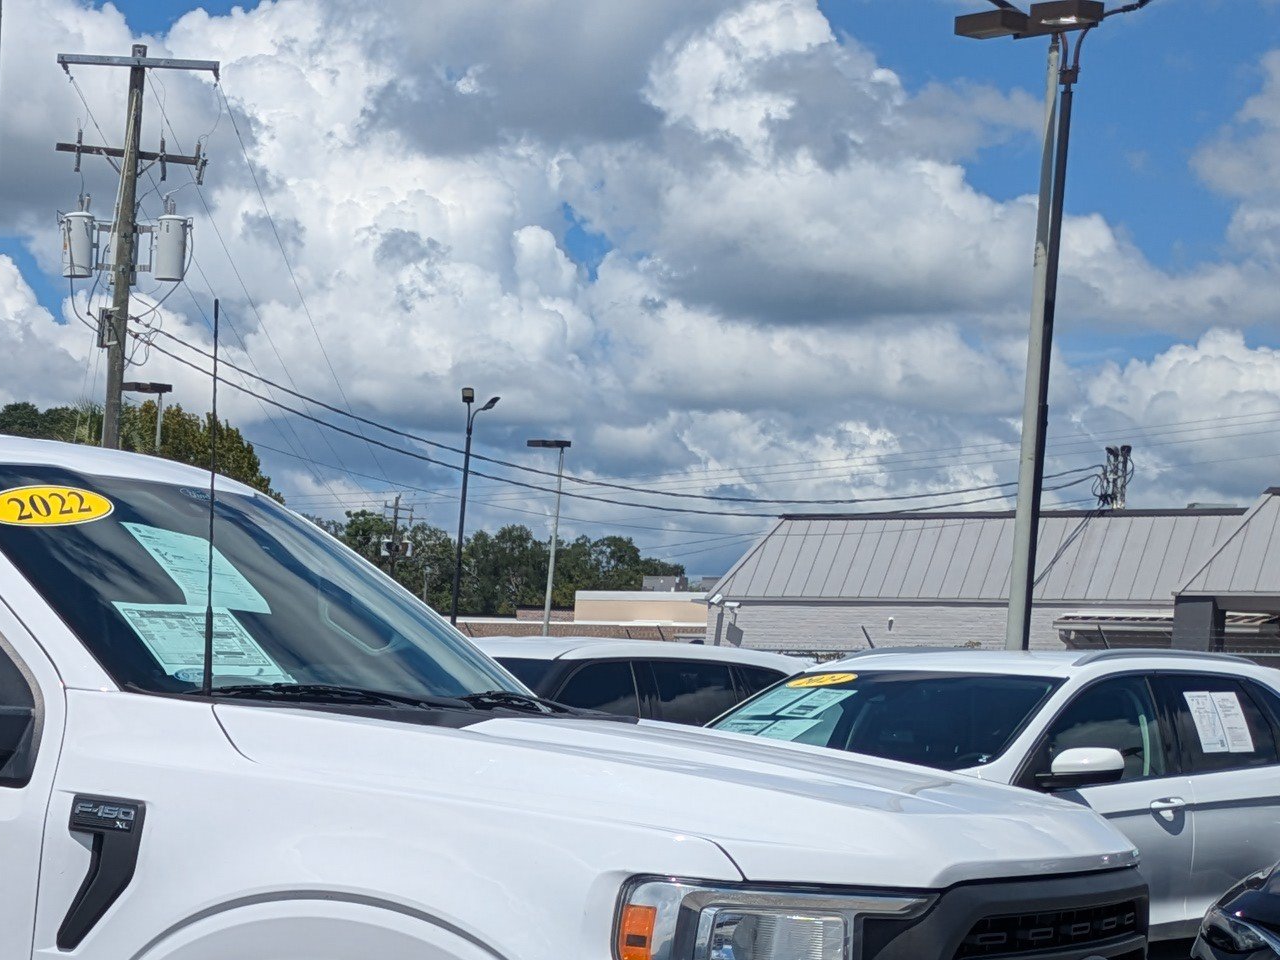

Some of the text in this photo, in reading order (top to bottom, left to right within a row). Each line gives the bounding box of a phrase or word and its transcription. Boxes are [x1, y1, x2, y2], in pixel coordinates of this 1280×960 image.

[6, 491, 93, 521] 2022
[74, 802, 135, 821] F-150
[115, 820, 129, 830] XL
